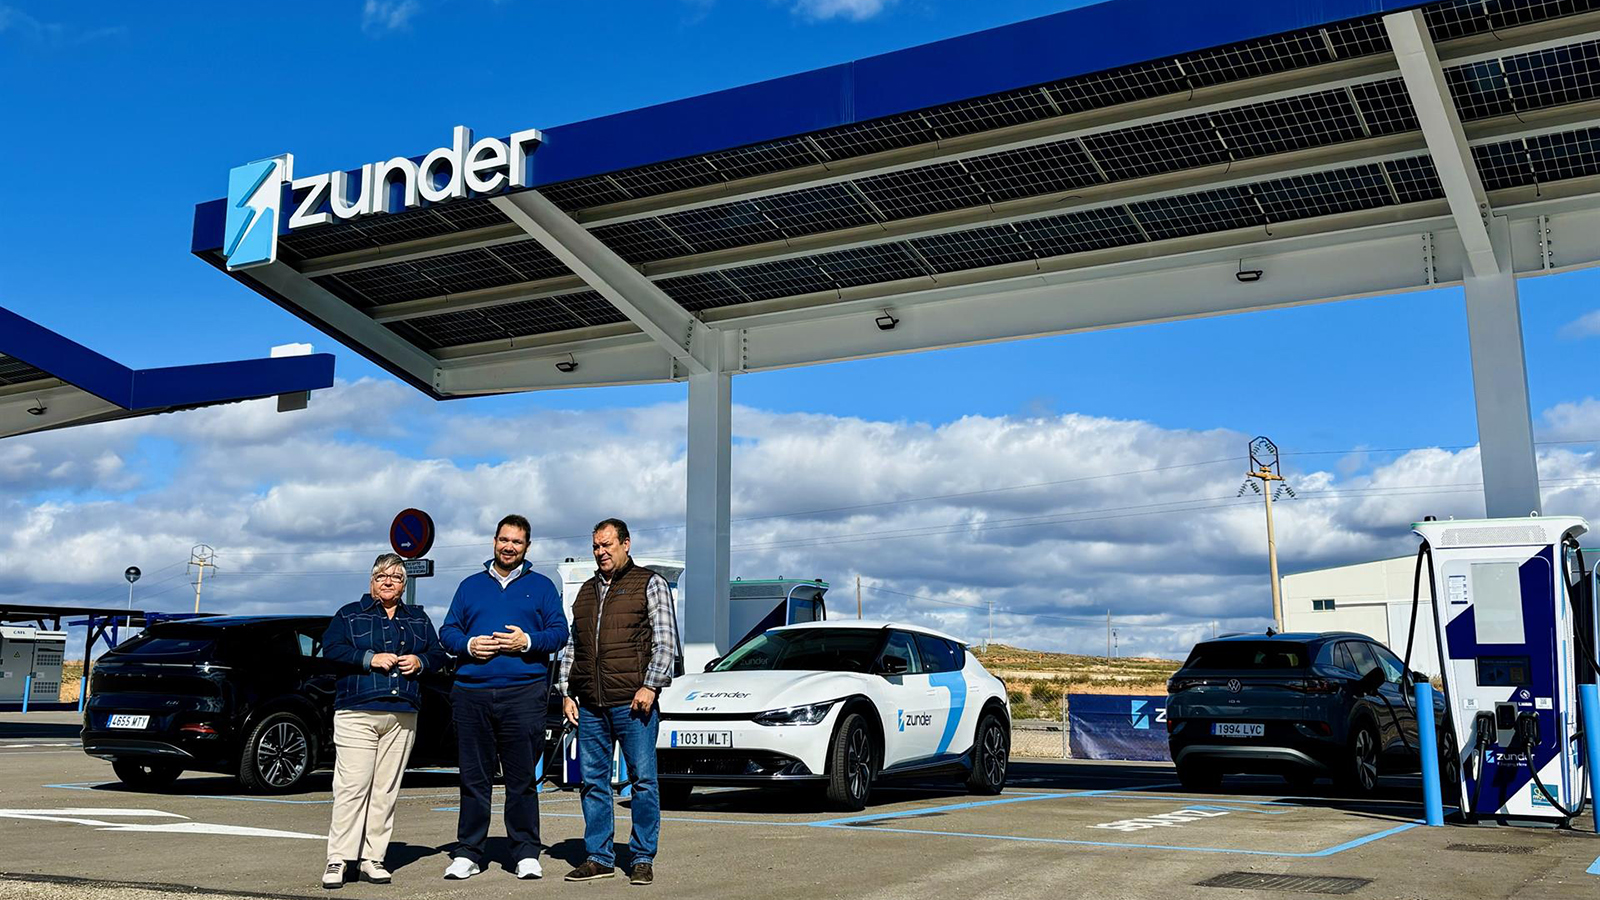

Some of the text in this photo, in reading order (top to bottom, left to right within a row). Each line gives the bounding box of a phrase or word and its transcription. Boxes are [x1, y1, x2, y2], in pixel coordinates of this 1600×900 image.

[288, 125, 542, 229] zunder
[700, 691, 751, 699] zunder
[112, 716, 148, 727] 4655 MTY
[906, 711, 932, 726] zunder
[1219, 724, 1262, 735] 1994 LVC
[680, 733, 728, 745] 1031 MLT
